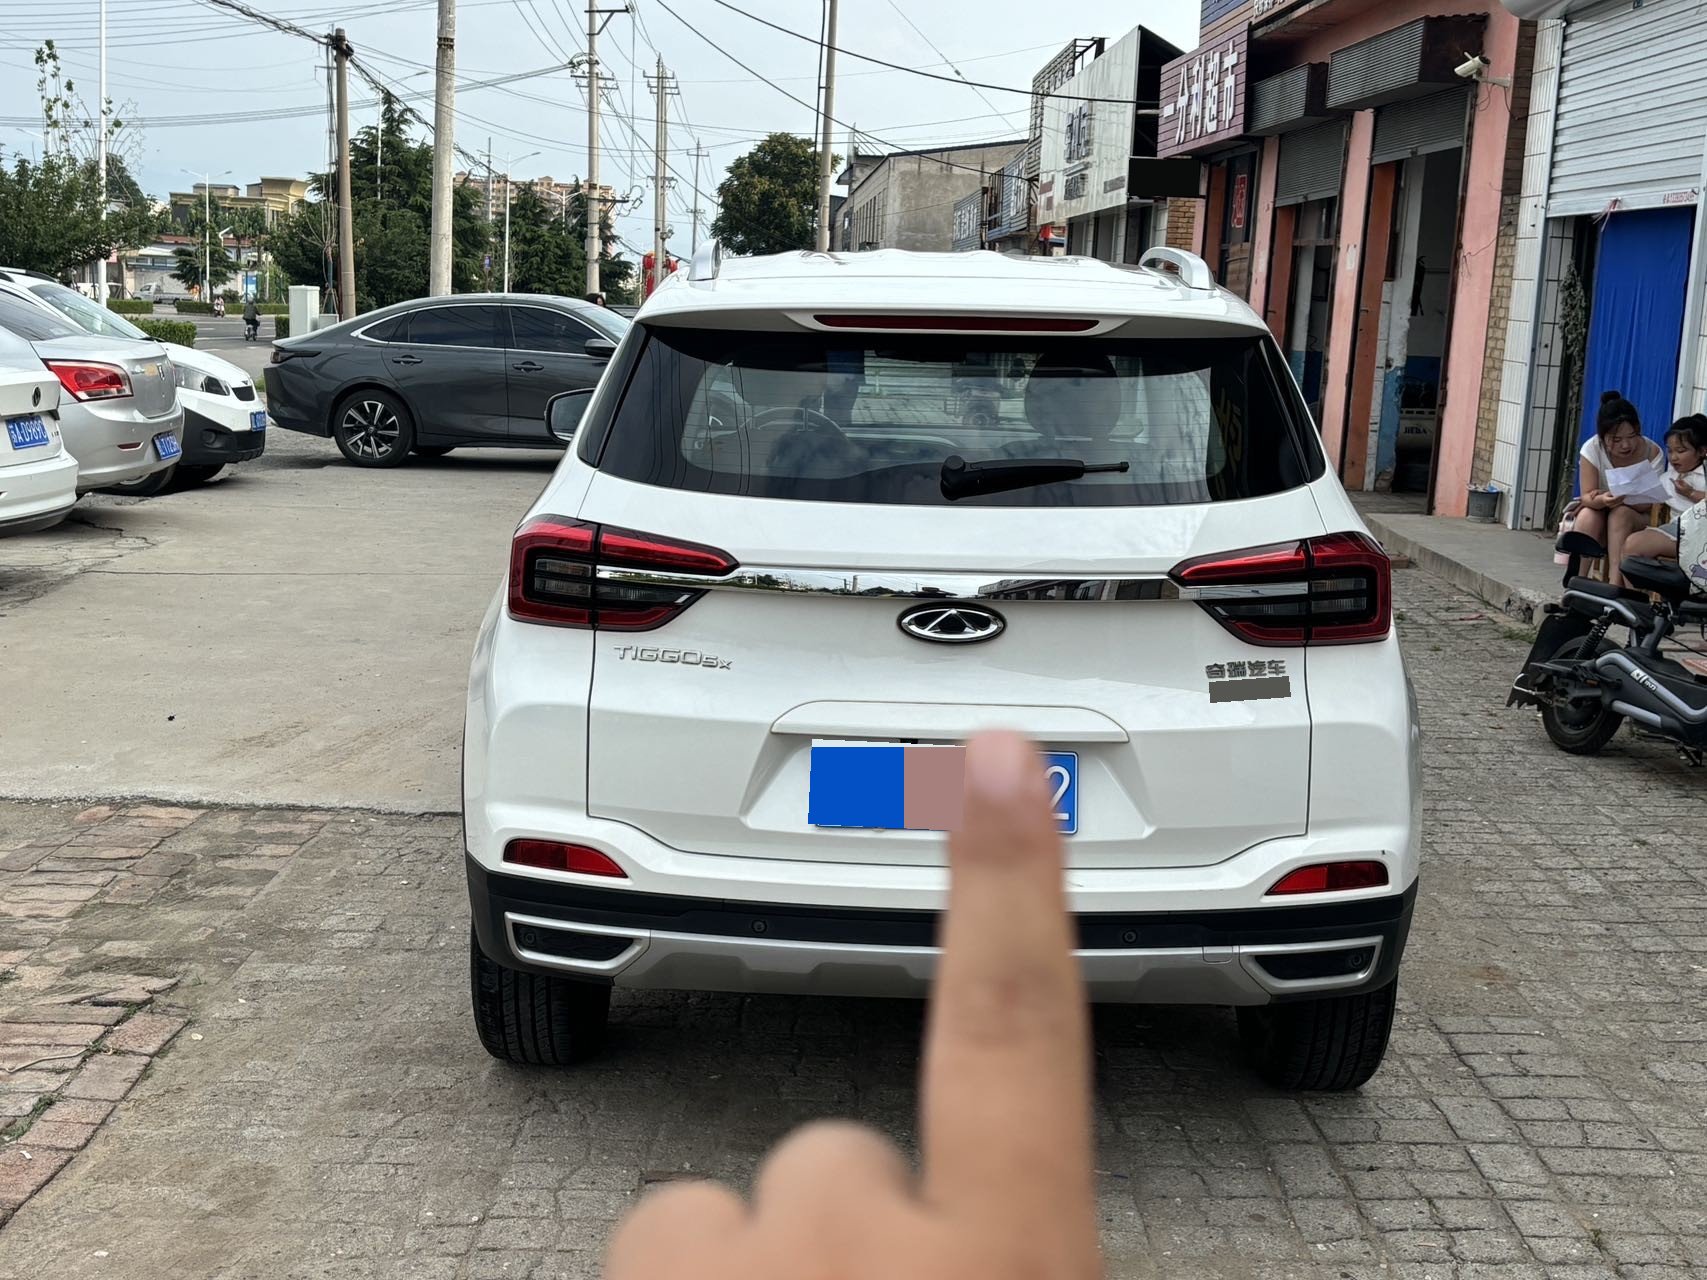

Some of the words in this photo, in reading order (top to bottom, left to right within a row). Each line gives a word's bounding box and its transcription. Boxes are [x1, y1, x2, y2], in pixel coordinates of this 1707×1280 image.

[1163, 40, 1238, 144] 一分利超市
[1205, 659, 1287, 678] 奇瑞汽车
